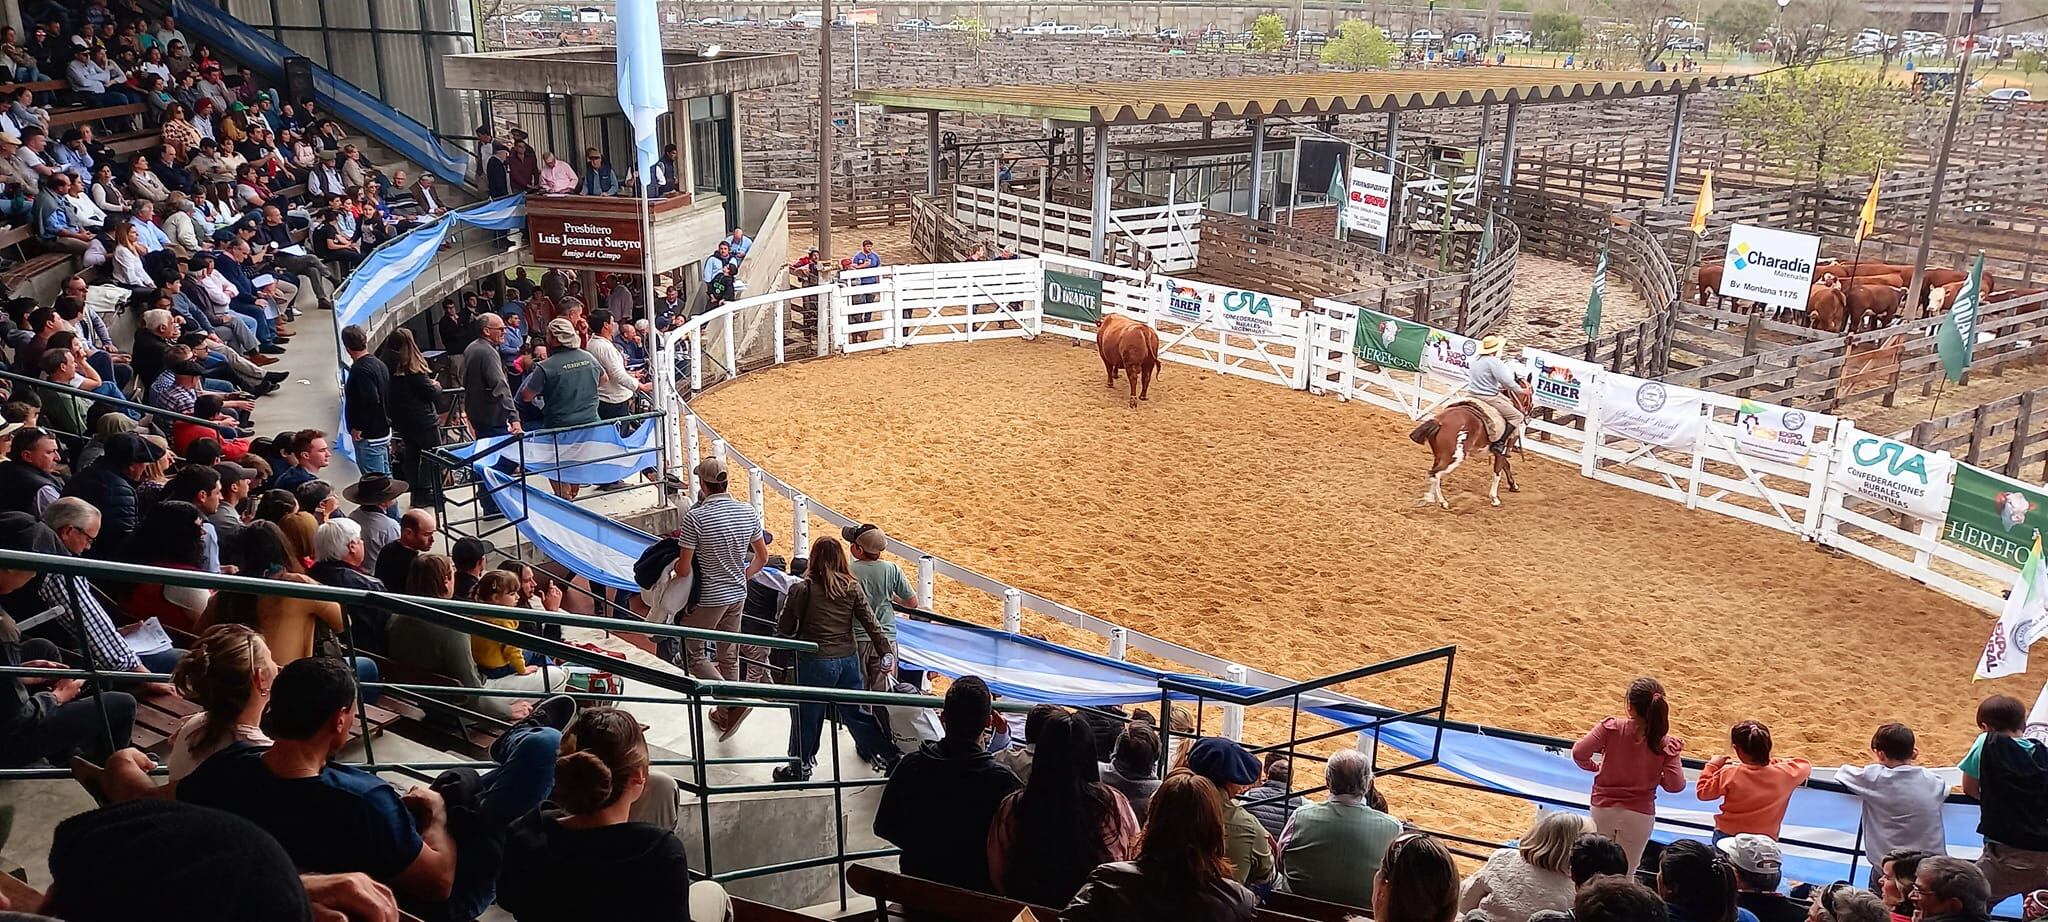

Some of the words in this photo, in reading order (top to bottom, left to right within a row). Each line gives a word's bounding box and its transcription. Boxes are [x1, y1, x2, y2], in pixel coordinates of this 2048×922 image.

[1352, 180, 1389, 193] TRANSPORTE
[538, 232, 560, 244] Luis
[562, 234, 603, 247] Jeannot
[604, 236, 641, 251] Sueyro
[562, 249, 584, 259] Amigo
[585, 250, 596, 258] del
[597, 251, 621, 261] Campo
[1747, 250, 1811, 274] Charadía
[1774, 270, 1808, 282] Materiales
[1062, 290, 1096, 310] DUARTE
[1778, 289, 1798, 300] 1175
[1169, 297, 1201, 313] FARER
[1536, 378, 1580, 400] FARER
[1777, 439, 1808, 448] RURAL
[1778, 430, 1804, 440] EXPO
[1847, 466, 1926, 498] CONFEDERACIONES
[1863, 481, 1901, 499] RURALES
[1857, 487, 1909, 509] ARGENTINAS
[1948, 521, 2032, 565] HEREFO
